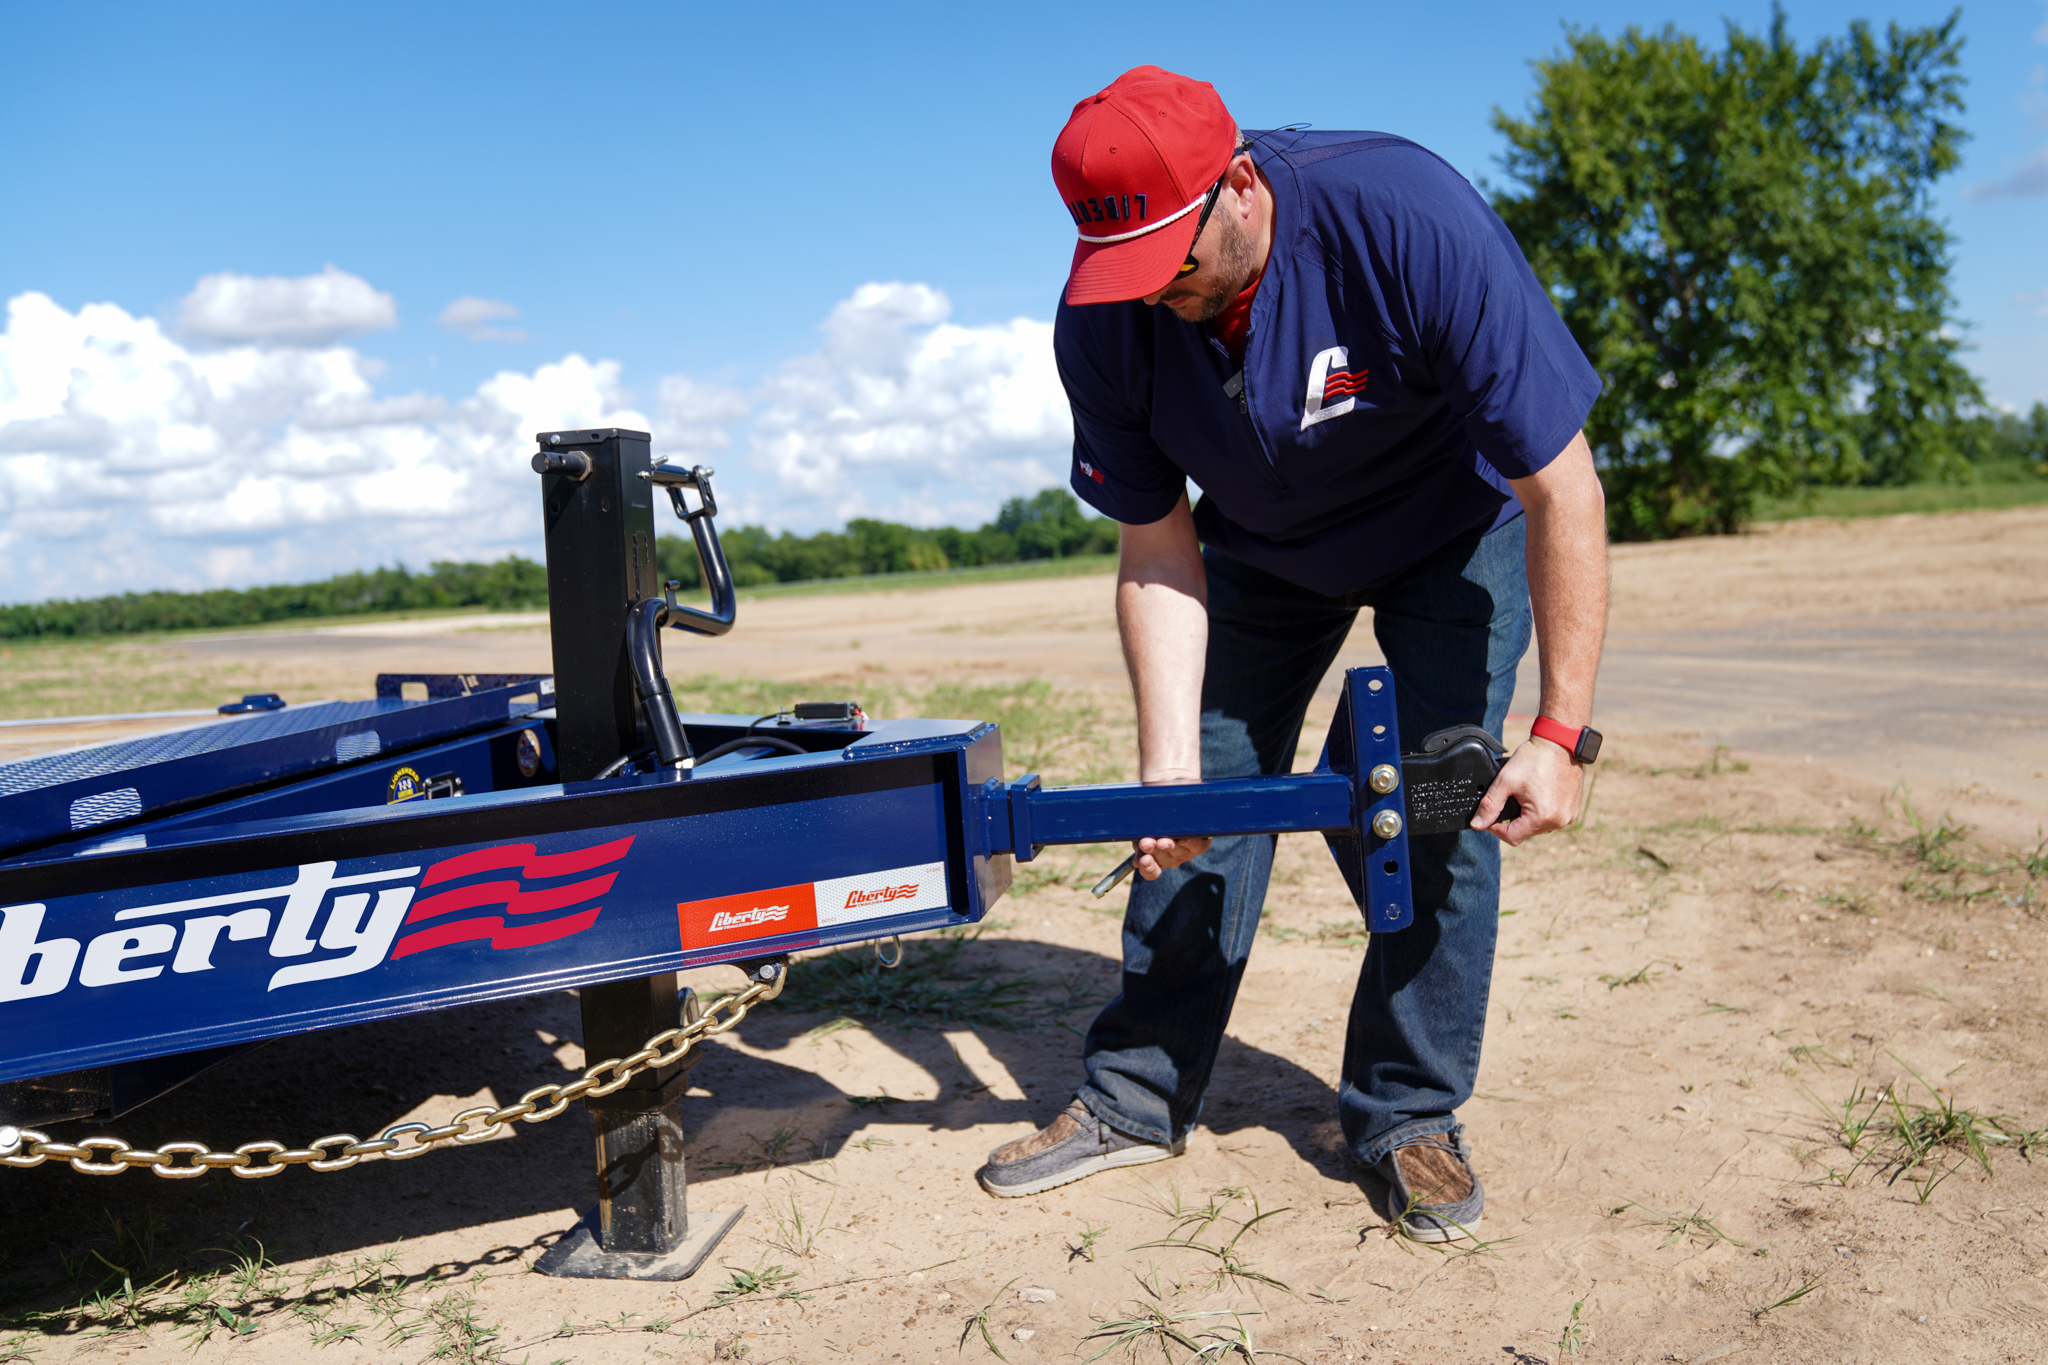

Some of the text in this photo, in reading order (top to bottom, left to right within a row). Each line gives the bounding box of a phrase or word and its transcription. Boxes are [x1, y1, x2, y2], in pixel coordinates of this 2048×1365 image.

[1067, 194, 1147, 227] LIBERT
[843, 886, 899, 909] Liberty
[708, 907, 767, 932] Liberty
